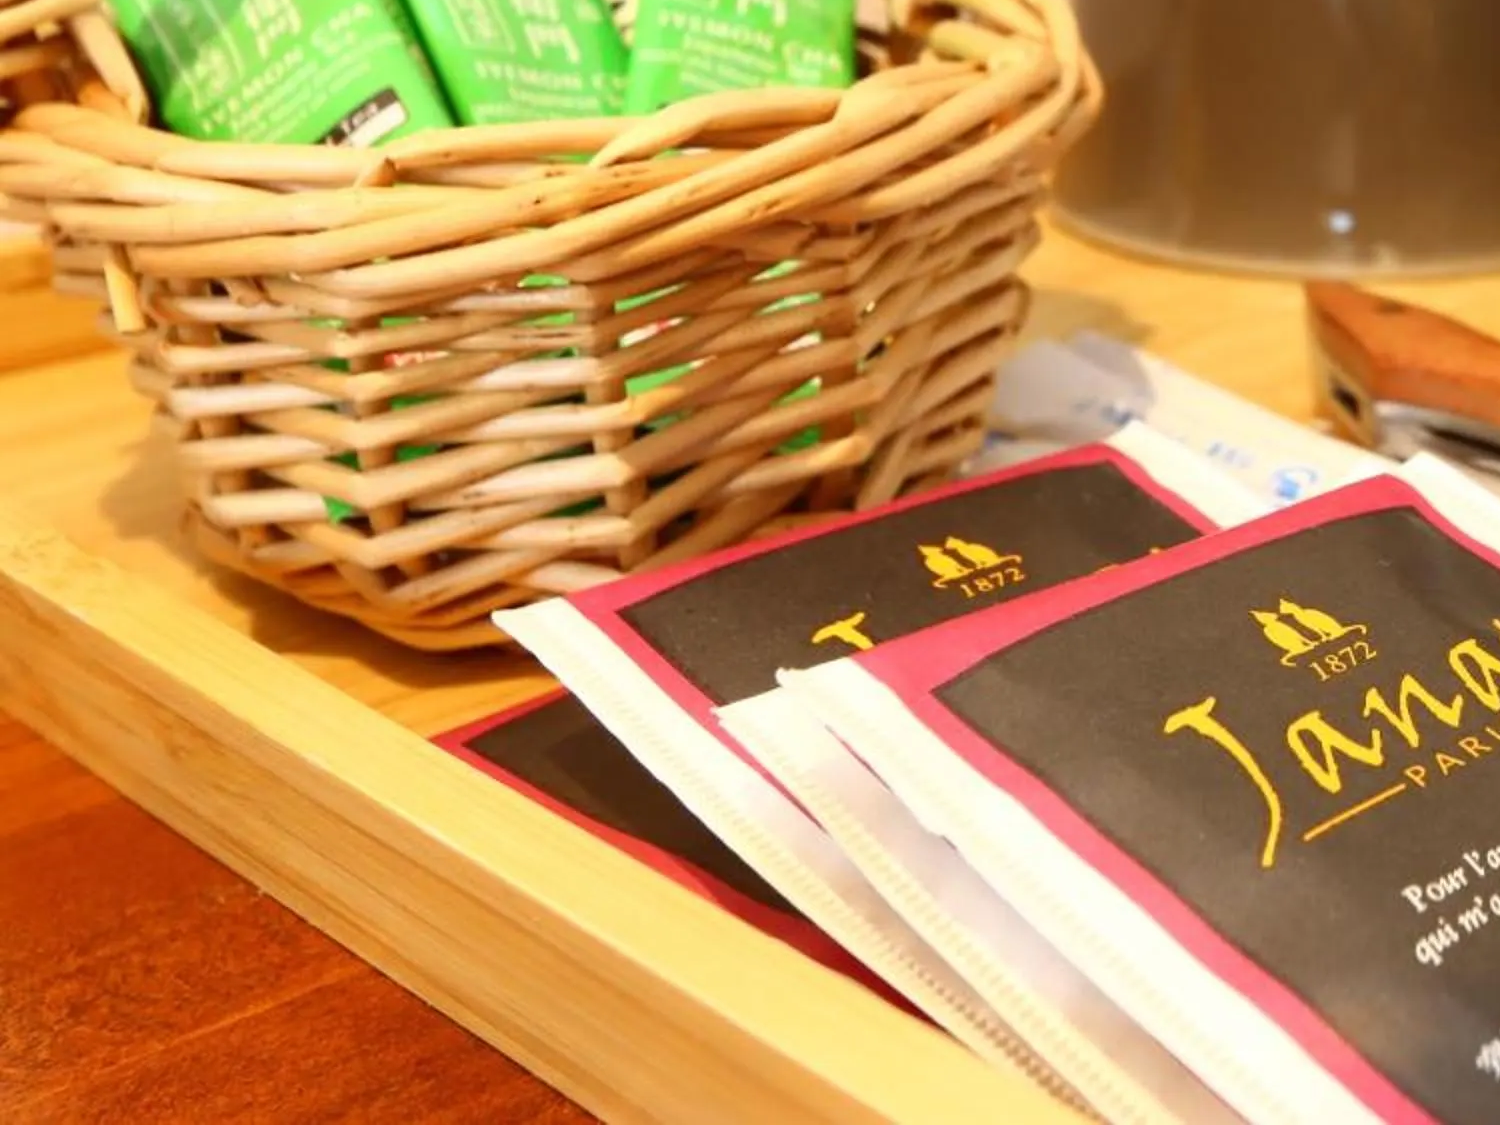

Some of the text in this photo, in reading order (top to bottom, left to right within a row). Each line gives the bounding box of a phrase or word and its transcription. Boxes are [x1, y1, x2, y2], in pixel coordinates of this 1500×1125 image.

[959, 566, 1026, 600] 1872
[1309, 640, 1378, 682] 1872
[1401, 864, 1468, 914] Pour
[1414, 917, 1460, 967] qui
